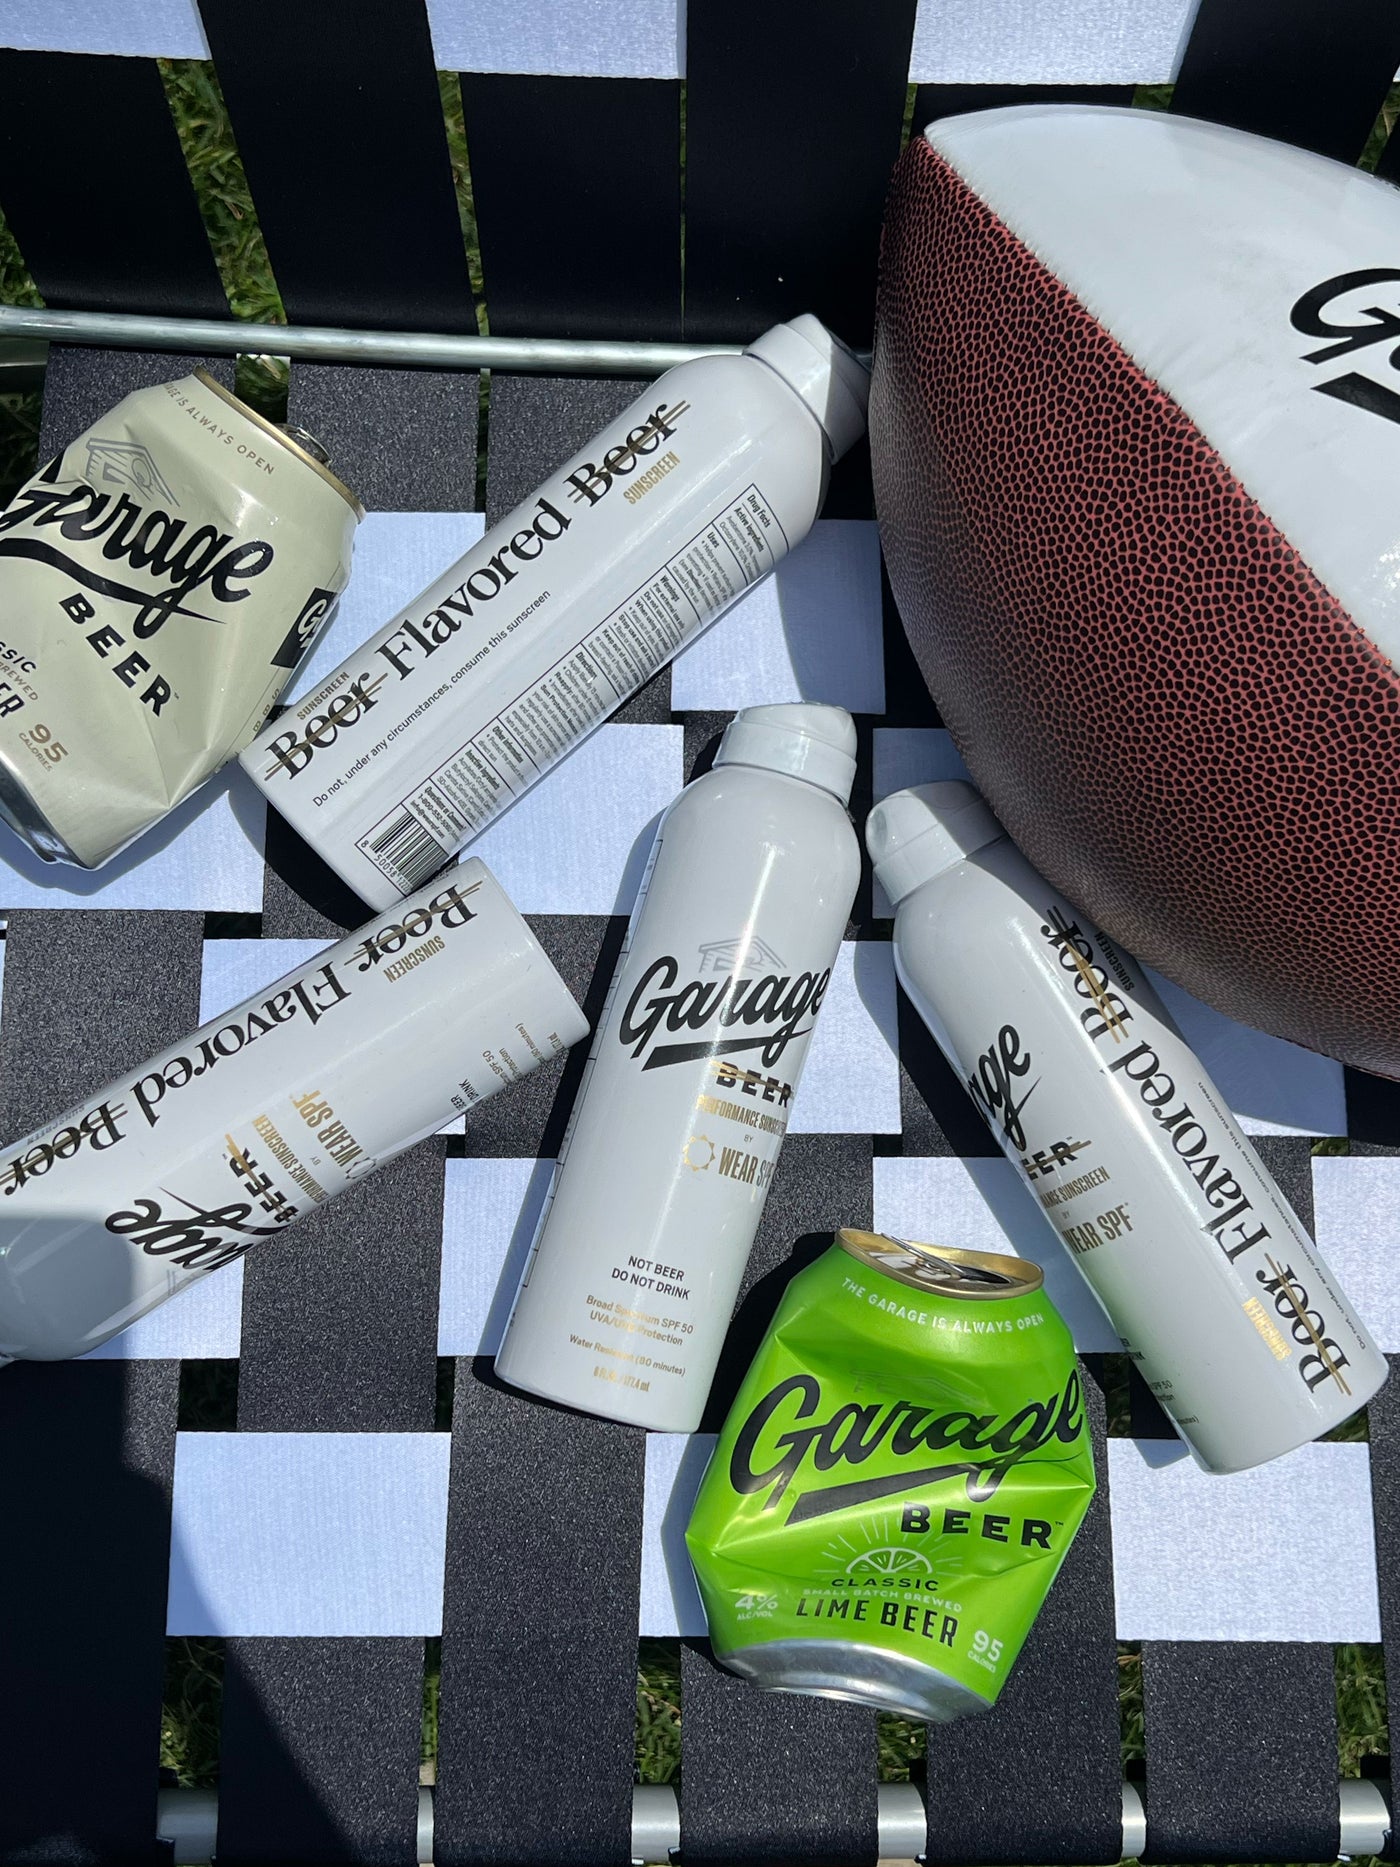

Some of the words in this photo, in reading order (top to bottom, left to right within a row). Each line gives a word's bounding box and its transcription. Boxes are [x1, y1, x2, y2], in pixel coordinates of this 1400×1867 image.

[185, 406, 234, 445] ALWAYS
[236, 442, 276, 475] OPEN
[622, 450, 681, 505] SUNSCREEN
[733, 505, 749, 527] Active
[746, 493, 761, 513] Drug
[706, 530, 721, 549] Uses
[264, 672, 382, 780] Beer
[374, 497, 573, 681] Flavored
[562, 403, 679, 508] Beer
[659, 574, 680, 603] Warnings
[58, 592, 173, 717] BEER
[296, 671, 350, 720] SUNSCREEN
[312, 793, 329, 807] Do
[327, 778, 348, 796] not,
[344, 753, 371, 779] under
[370, 739, 388, 757] any
[386, 683, 450, 742] circumstances,
[450, 646, 491, 684] consume
[488, 630, 508, 648] this
[506, 590, 551, 633] sunscreen
[16, 730, 53, 772] CALORIES
[28, 723, 69, 764] 95
[351, 883, 478, 972] Beer
[382, 935, 446, 983] SUNSCREEN
[1093, 930, 1135, 992] SUNSCREEN
[619, 955, 830, 1067] Garage
[129, 960, 352, 1124] Flavored
[715, 1061, 793, 1108] BEER
[1198, 1081, 1230, 1130] sunscreen
[294, 1091, 334, 1129] SPF
[4, 1101, 127, 1196] Beer
[251, 1114, 298, 1169] SUNSCREEN
[315, 1119, 363, 1167] WEAR
[1024, 1138, 1079, 1181] EER
[1040, 909, 1134, 1041] Beer
[1108, 1039, 1272, 1266] Flavored
[1255, 1261, 1351, 1394] Beer
[1229, 1132, 1242, 1150] this
[717, 1146, 759, 1184] WEAR
[1059, 1165, 1111, 1202] SUNSCREEN
[1241, 1150, 1270, 1193] consume
[1096, 1204, 1134, 1241] SPF
[627, 1255, 653, 1272] NOT
[653, 1263, 685, 1282] BEER
[629, 1273, 655, 1289] NOT
[655, 1281, 690, 1300] DRINK
[585, 1294, 614, 1311] Broad
[841, 1277, 866, 1297] THE
[868, 1293, 927, 1325] GARAGE
[952, 1318, 1012, 1333] ALWAYS
[1016, 1314, 1044, 1330] OPEN
[1325, 1287, 1345, 1314] under
[569, 1333, 593, 1349] Water
[651, 1359, 686, 1376] minutes)
[636, 1324, 684, 1346] Protection
[729, 1368, 1084, 1512] Garage
[900, 1500, 1052, 1550] BEER
[734, 1593, 778, 1610] 4%
[831, 1577, 939, 1592] CLASSIC
[903, 1592, 963, 1612] BREWED
[795, 1598, 870, 1621] LIME
[880, 1601, 958, 1648] BEER
[971, 1629, 1004, 1662] 95
